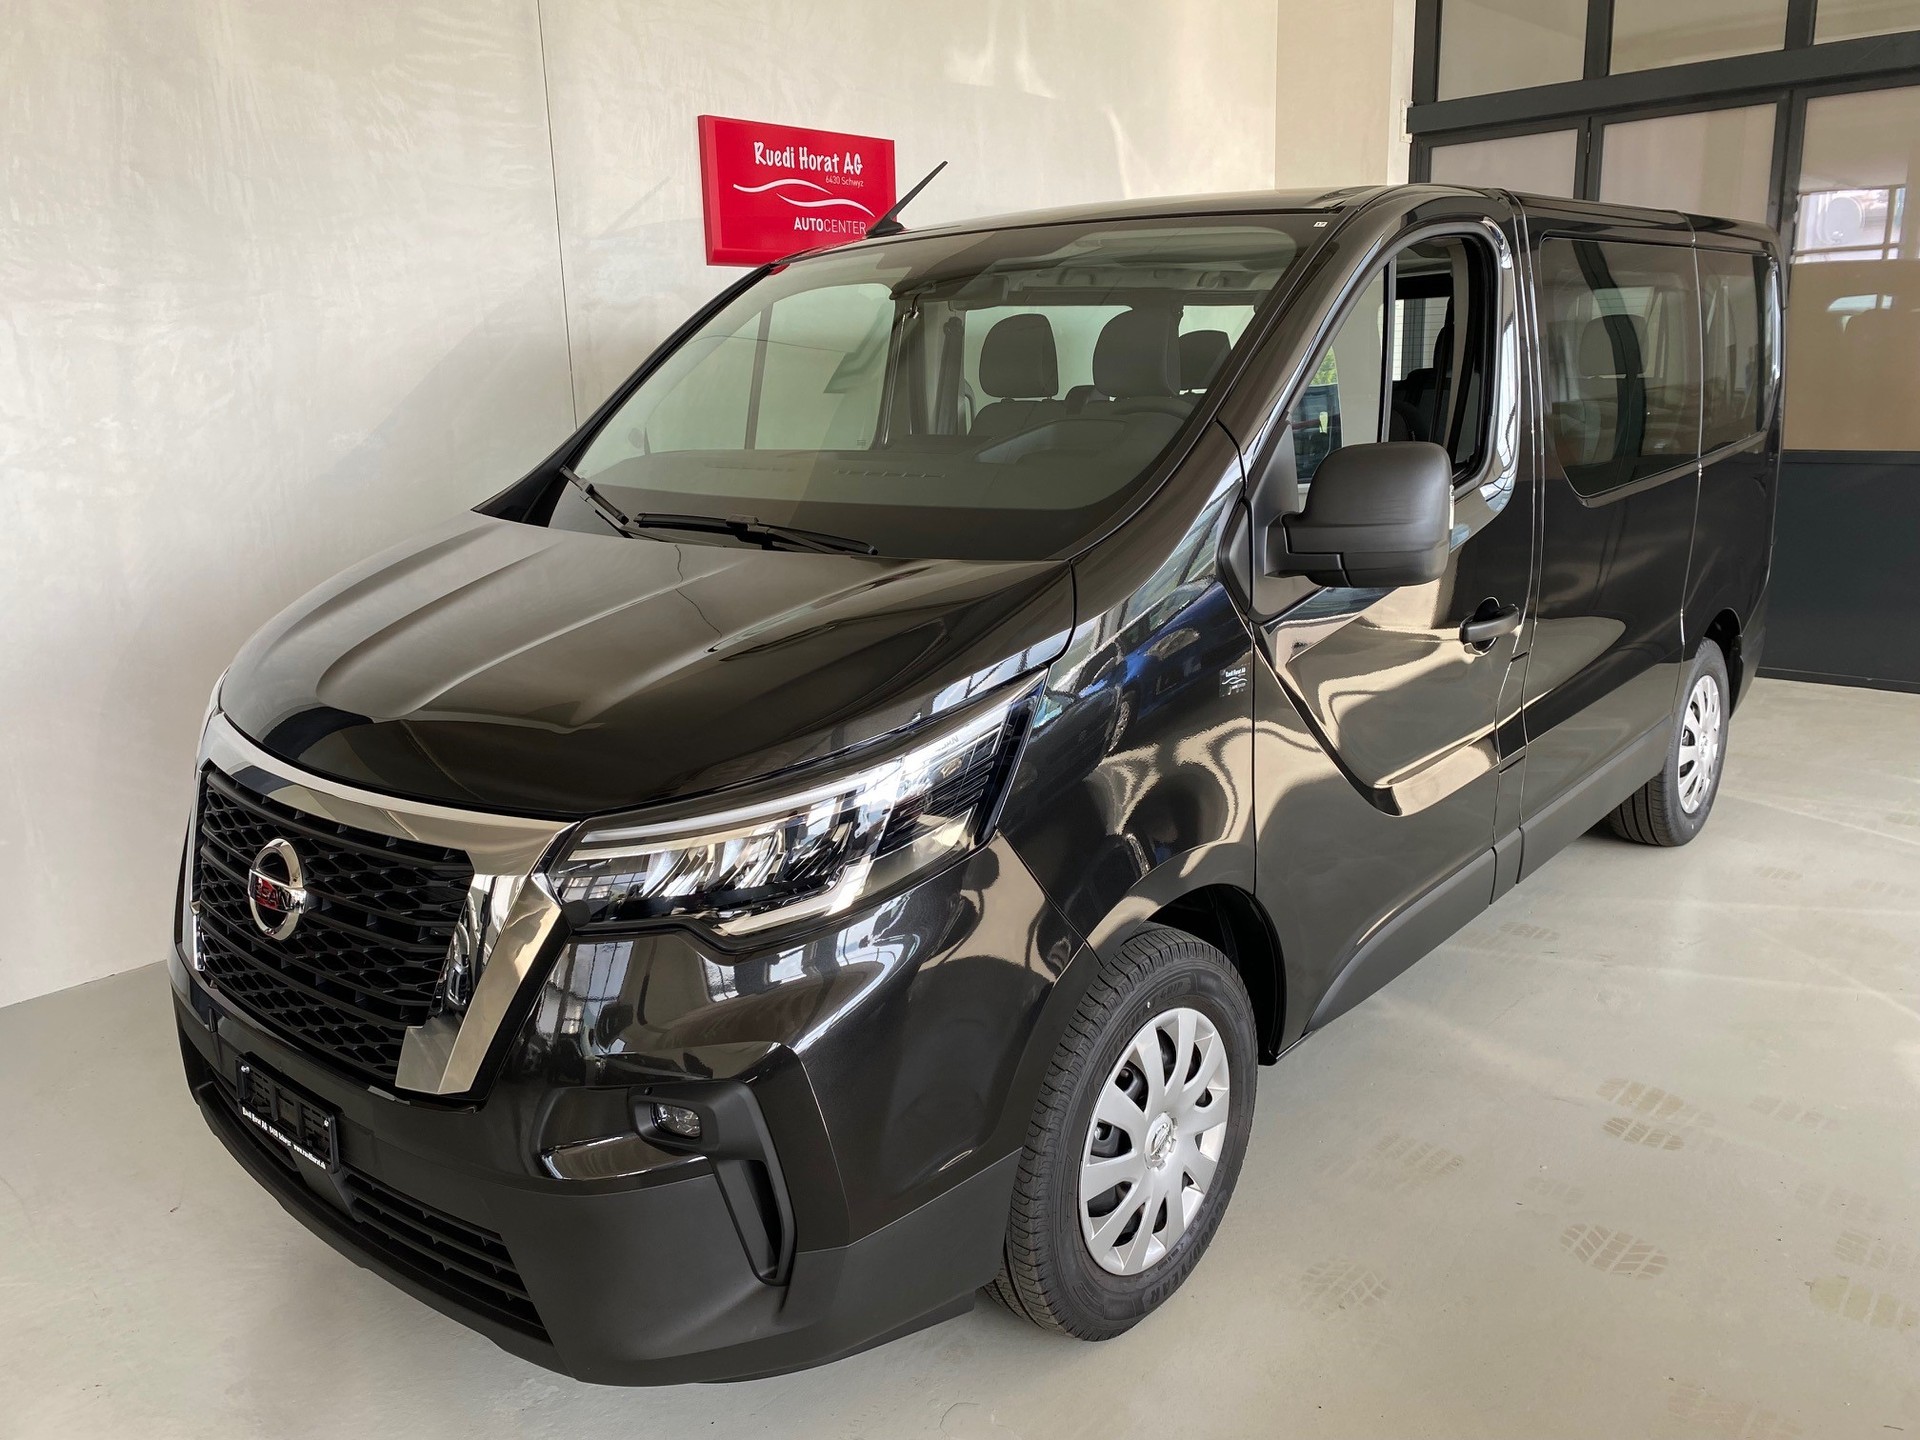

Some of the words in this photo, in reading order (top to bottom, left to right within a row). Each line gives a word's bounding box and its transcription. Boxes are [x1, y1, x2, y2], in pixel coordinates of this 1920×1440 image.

[754, 141, 795, 169] Ruedi
[799, 146, 840, 174] Horat
[843, 151, 864, 176] AG
[825, 175, 841, 185] 6430
[841, 176, 864, 188] Schwyz
[794, 216, 867, 235] AUTOCENTER
